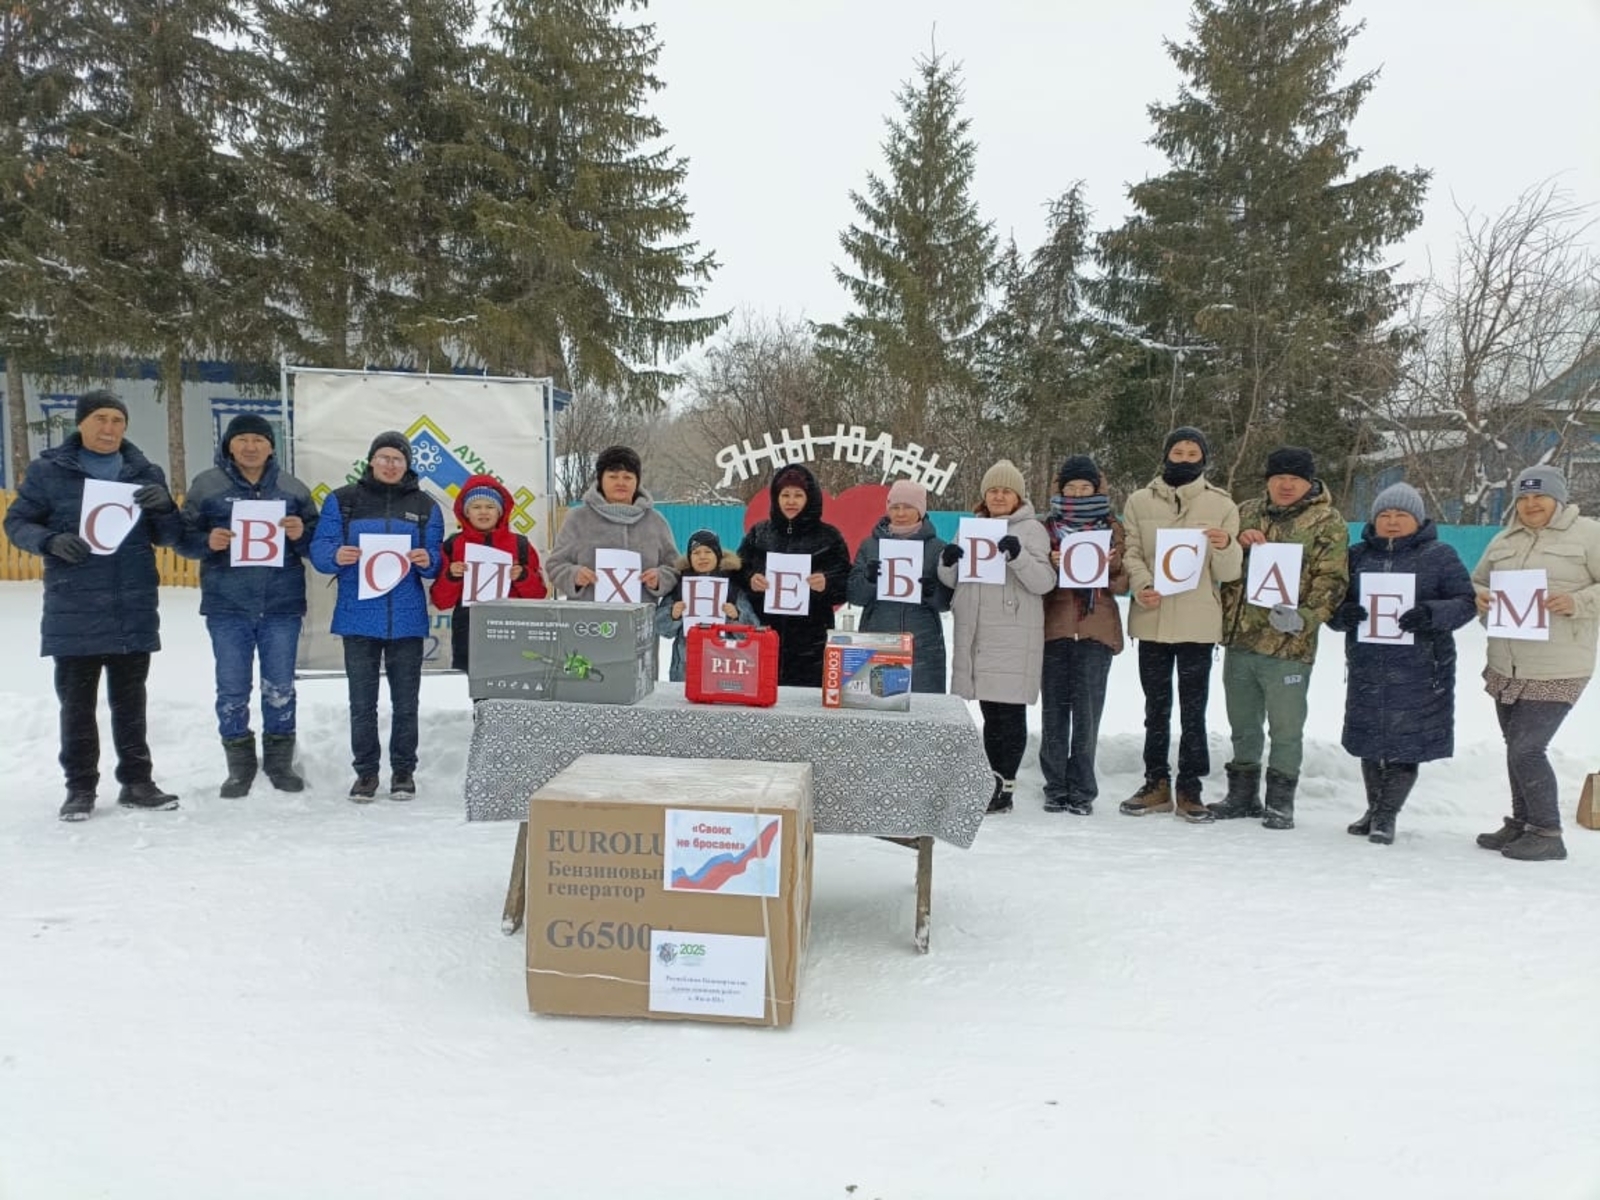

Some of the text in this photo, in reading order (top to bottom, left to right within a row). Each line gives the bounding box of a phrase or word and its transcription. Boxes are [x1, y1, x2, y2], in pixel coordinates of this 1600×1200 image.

[453, 444, 504, 483] АУЫ
[85, 502, 133, 551] С
[234, 518, 279, 562] В
[365, 550, 409, 592] О
[964, 536, 998, 579] Р
[1063, 541, 1107, 585] О
[1162, 544, 1198, 583] С
[464, 561, 512, 603] И
[598, 567, 639, 603] Х
[769, 570, 803, 612] Е
[882, 557, 915, 598] Б
[1251, 561, 1295, 606] А
[684, 579, 726, 618] Н
[1364, 593, 1404, 640] Е
[1491, 588, 1548, 629] М
[711, 657, 750, 675] P.I.T.
[828, 650, 840, 689] СОЮЗ
[547, 829, 664, 856] EUROLU
[677, 838, 746, 851] не бросаем»
[692, 823, 733, 836] «Своих
[547, 883, 645, 903] генератор
[547, 919, 650, 951] G6500
[680, 944, 706, 956] 2025
